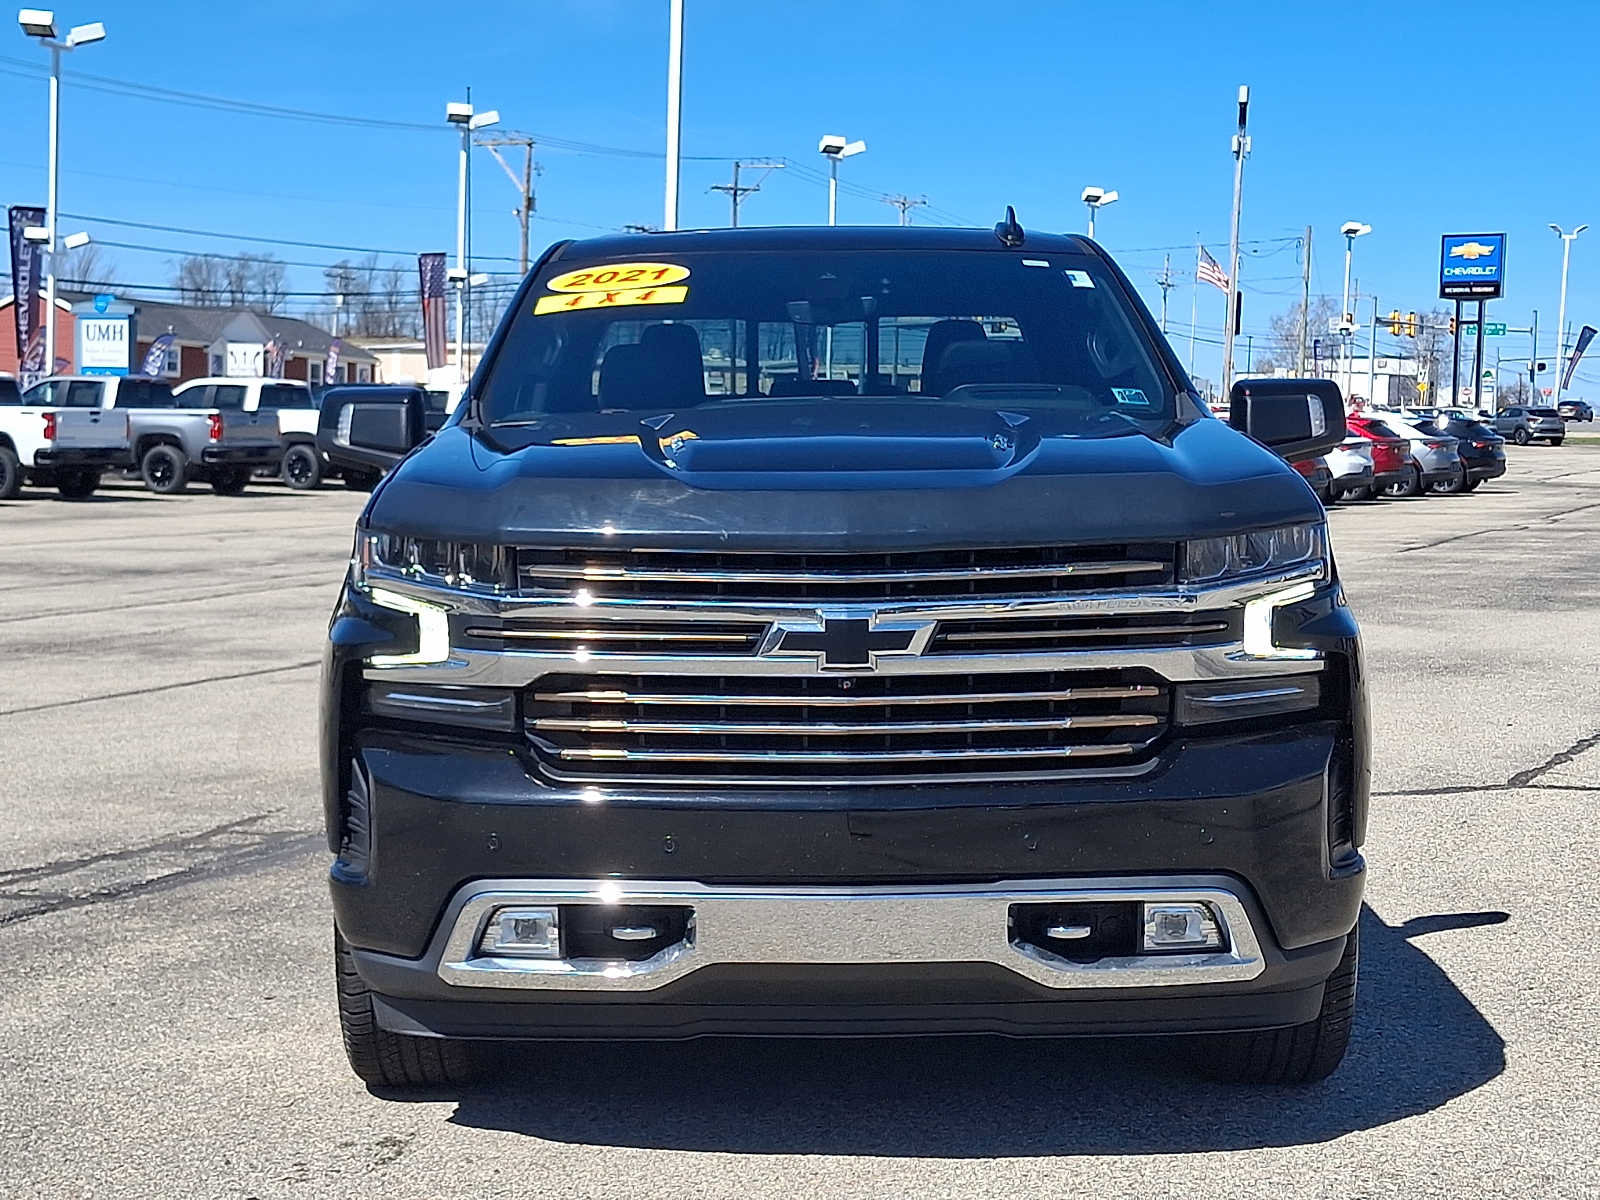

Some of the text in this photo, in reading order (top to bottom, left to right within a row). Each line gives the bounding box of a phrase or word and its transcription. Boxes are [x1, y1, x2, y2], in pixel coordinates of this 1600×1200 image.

[564, 267, 670, 288] 2021
[1443, 266, 1497, 276] CHEVROLET
[86, 324, 123, 342] UMH
